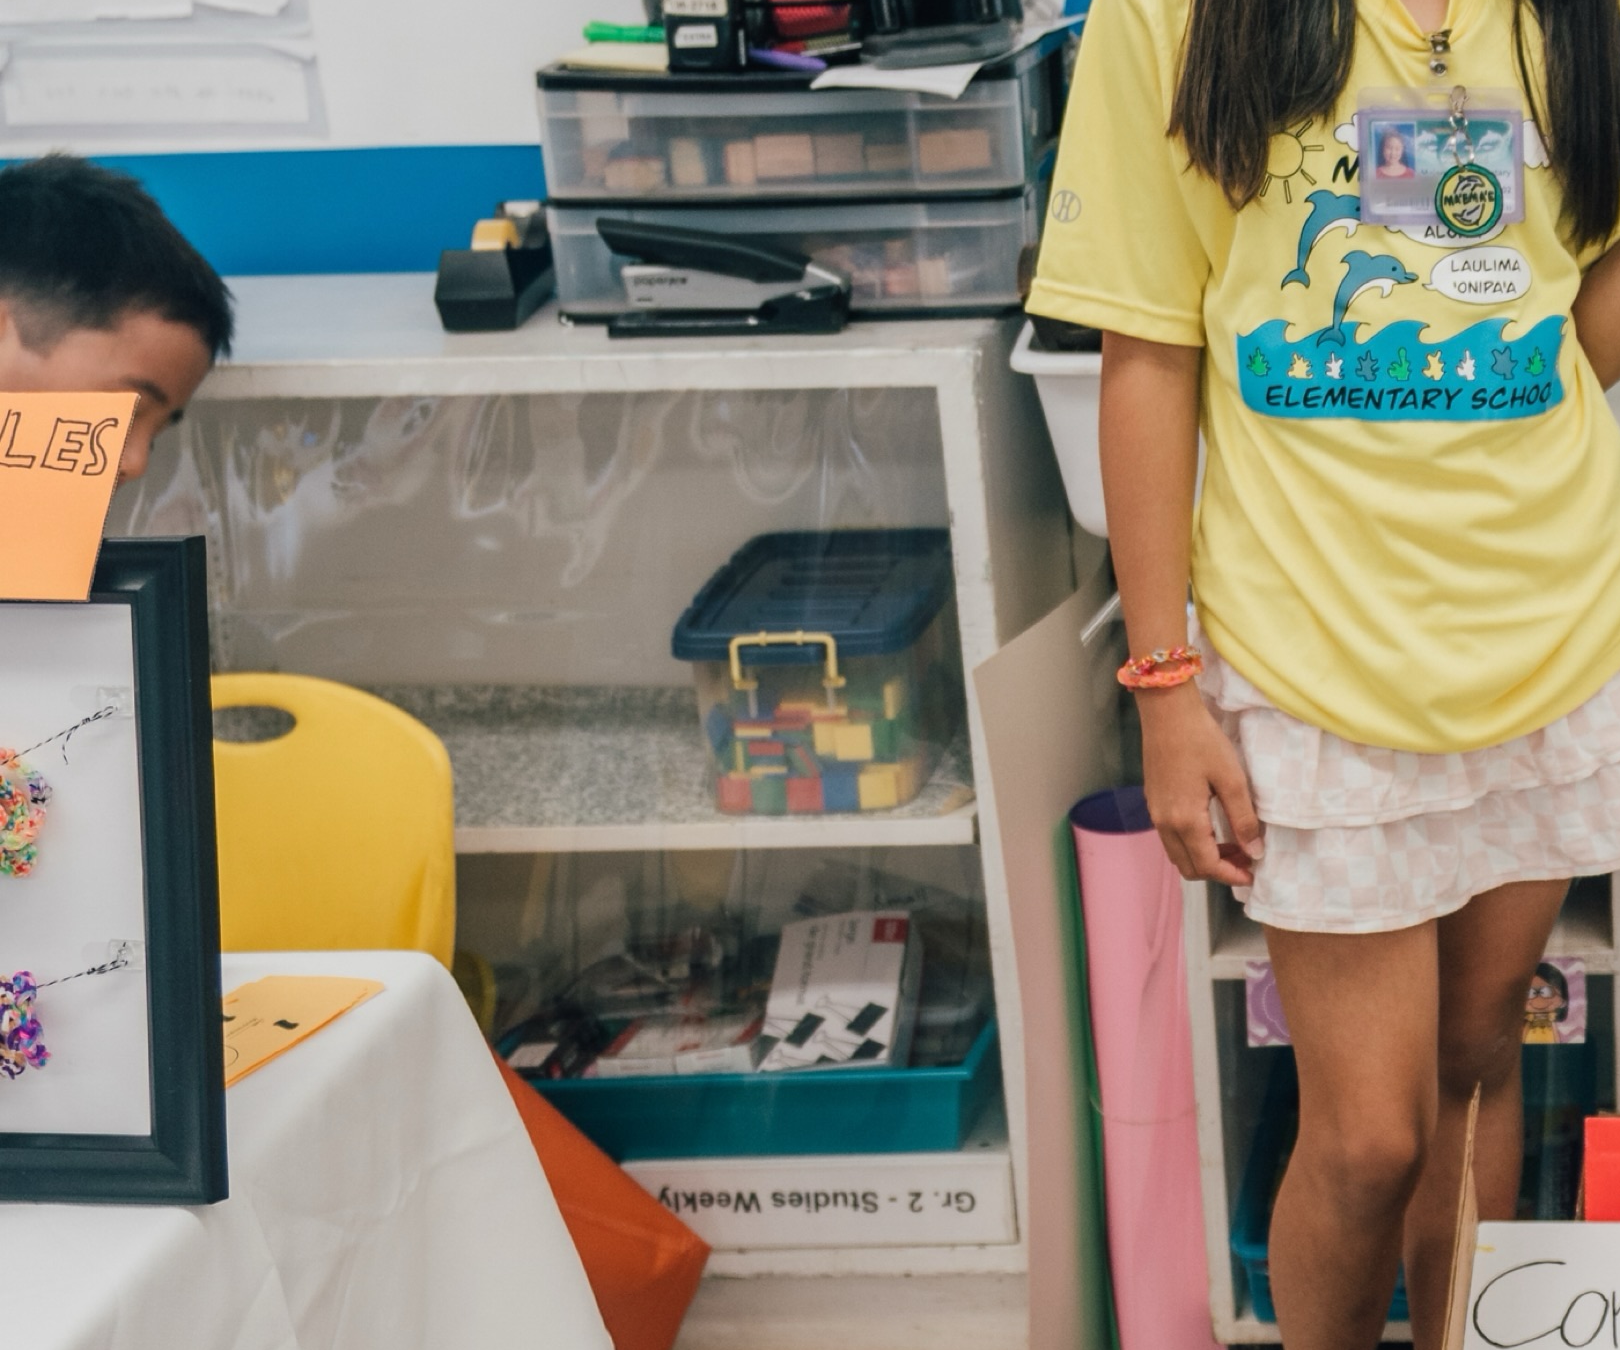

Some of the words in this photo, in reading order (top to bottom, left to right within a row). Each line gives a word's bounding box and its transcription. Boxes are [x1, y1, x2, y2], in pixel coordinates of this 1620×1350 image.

[1451, 258, 1522, 273] LAULIMA
[1452, 280, 1518, 295] 'ONIPA'A
[1264, 383, 1465, 412] ELEMENTARY
[1470, 383, 1555, 411] SCHOO
[656, 1185, 762, 1214] Weekly
[771, 1190, 879, 1214] Studies
[908, 1191, 924, 1213] 2
[933, 1191, 976, 1212] Gr.
